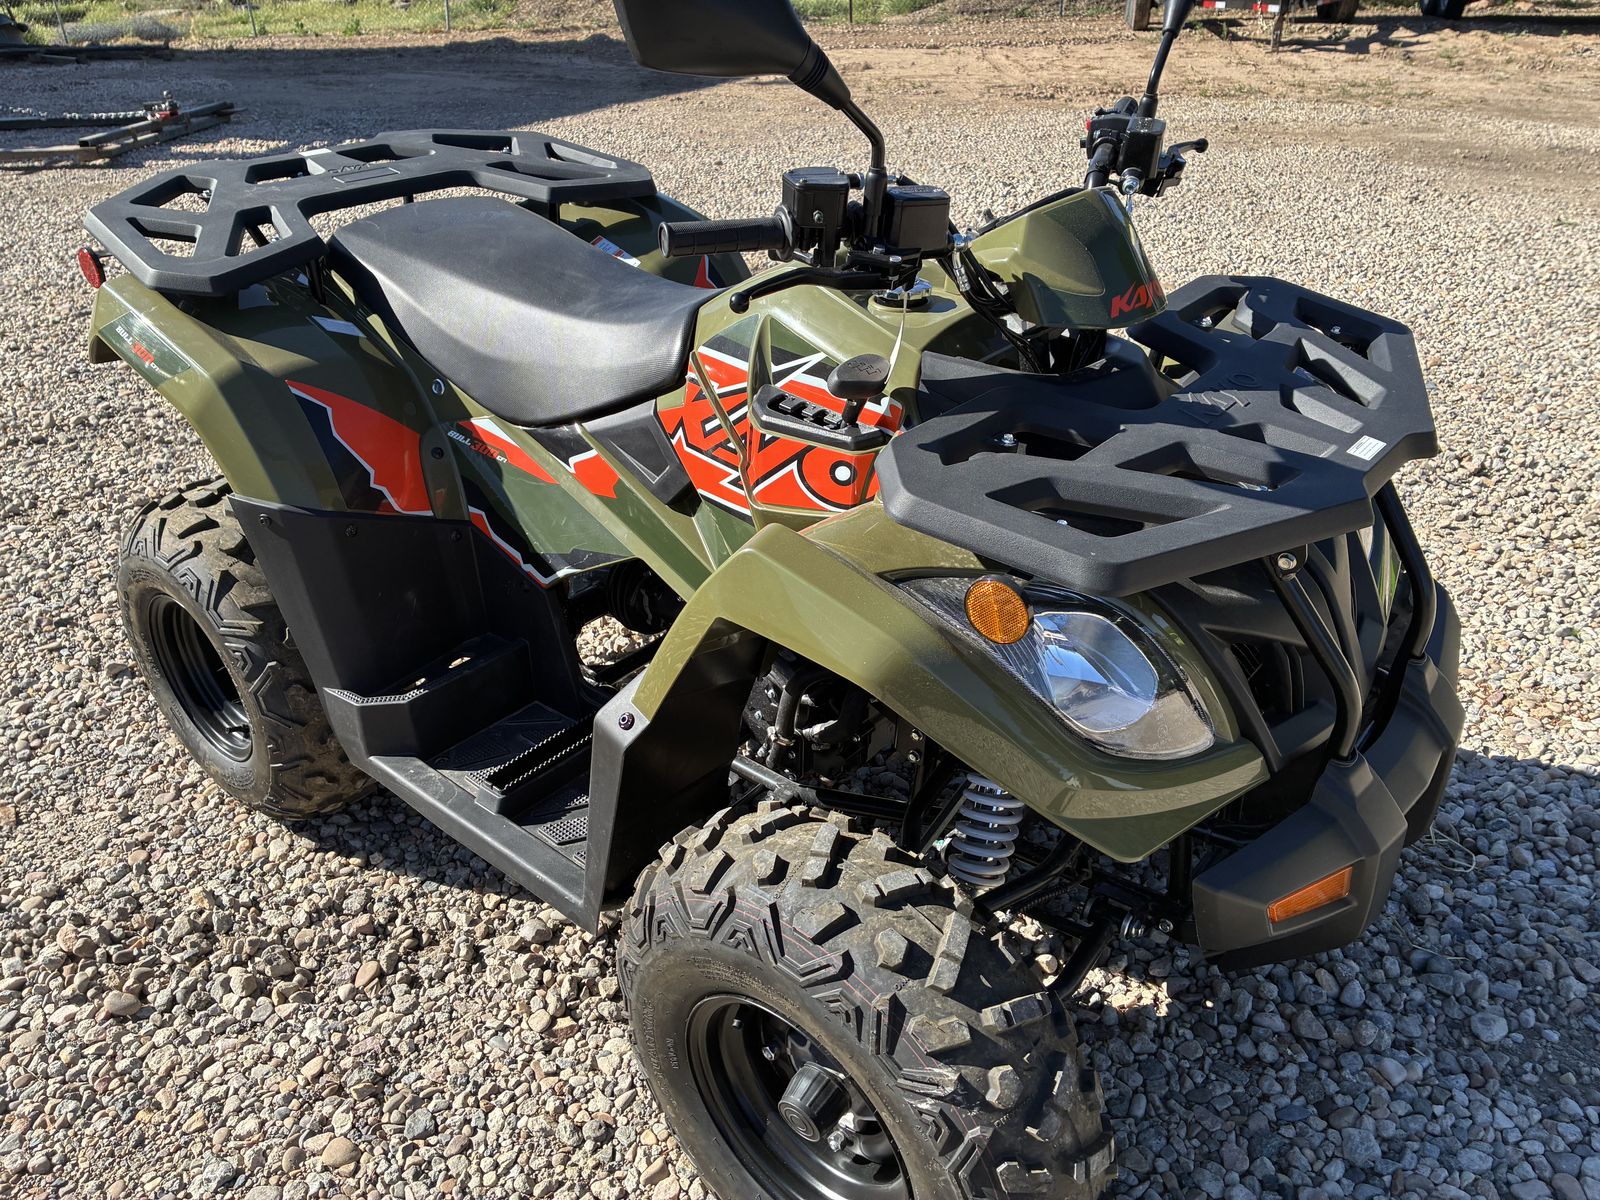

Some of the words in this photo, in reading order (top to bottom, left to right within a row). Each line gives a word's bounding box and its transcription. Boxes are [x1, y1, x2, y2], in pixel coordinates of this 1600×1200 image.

[115, 325, 133, 346] BULL
[446, 430, 471, 446] BULL
[470, 440, 500, 460] 300
